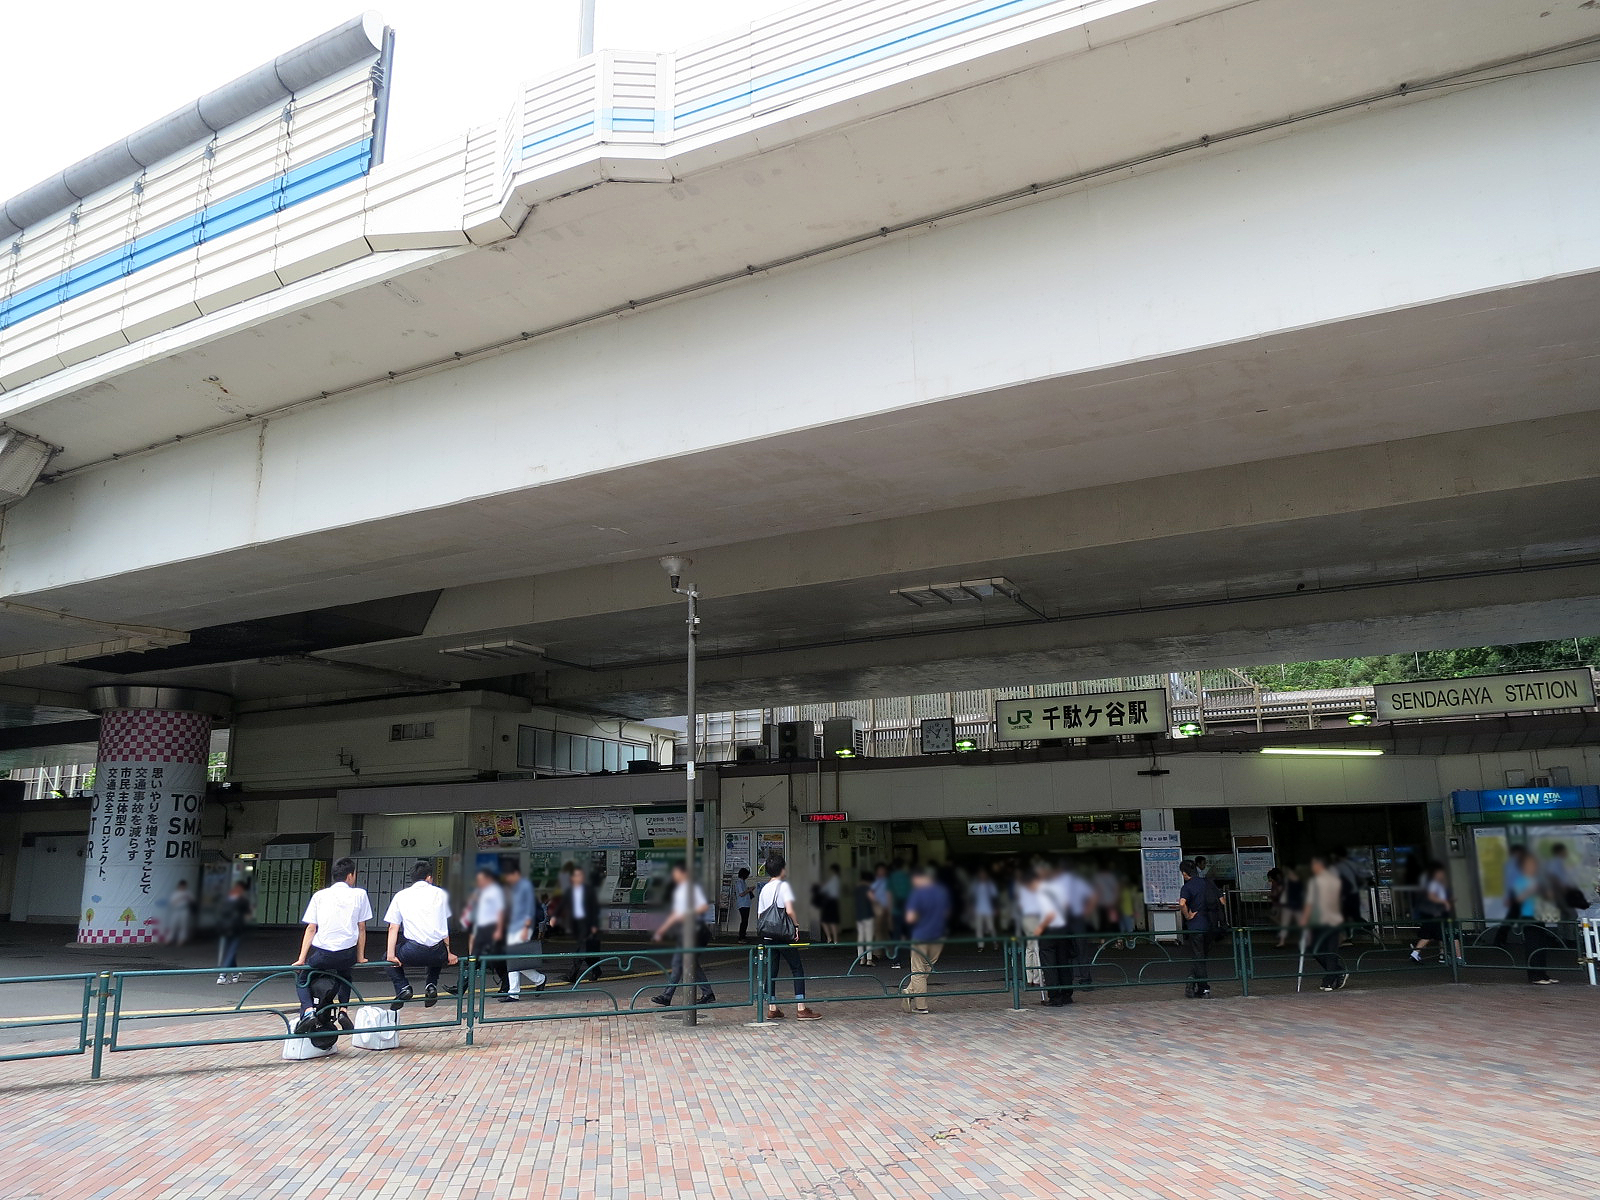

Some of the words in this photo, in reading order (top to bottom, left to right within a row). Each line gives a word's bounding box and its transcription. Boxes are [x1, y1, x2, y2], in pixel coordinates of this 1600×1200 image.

[1007, 709, 1033, 725] JR
[1391, 686, 1493, 711] SENDAGAYA
[1504, 680, 1578, 703] STATION
[114, 767, 132, 837] 市民主体型の
[127, 767, 149, 862] 交通事故を減らす
[140, 767, 164, 894] 思いやりを増やすことで
